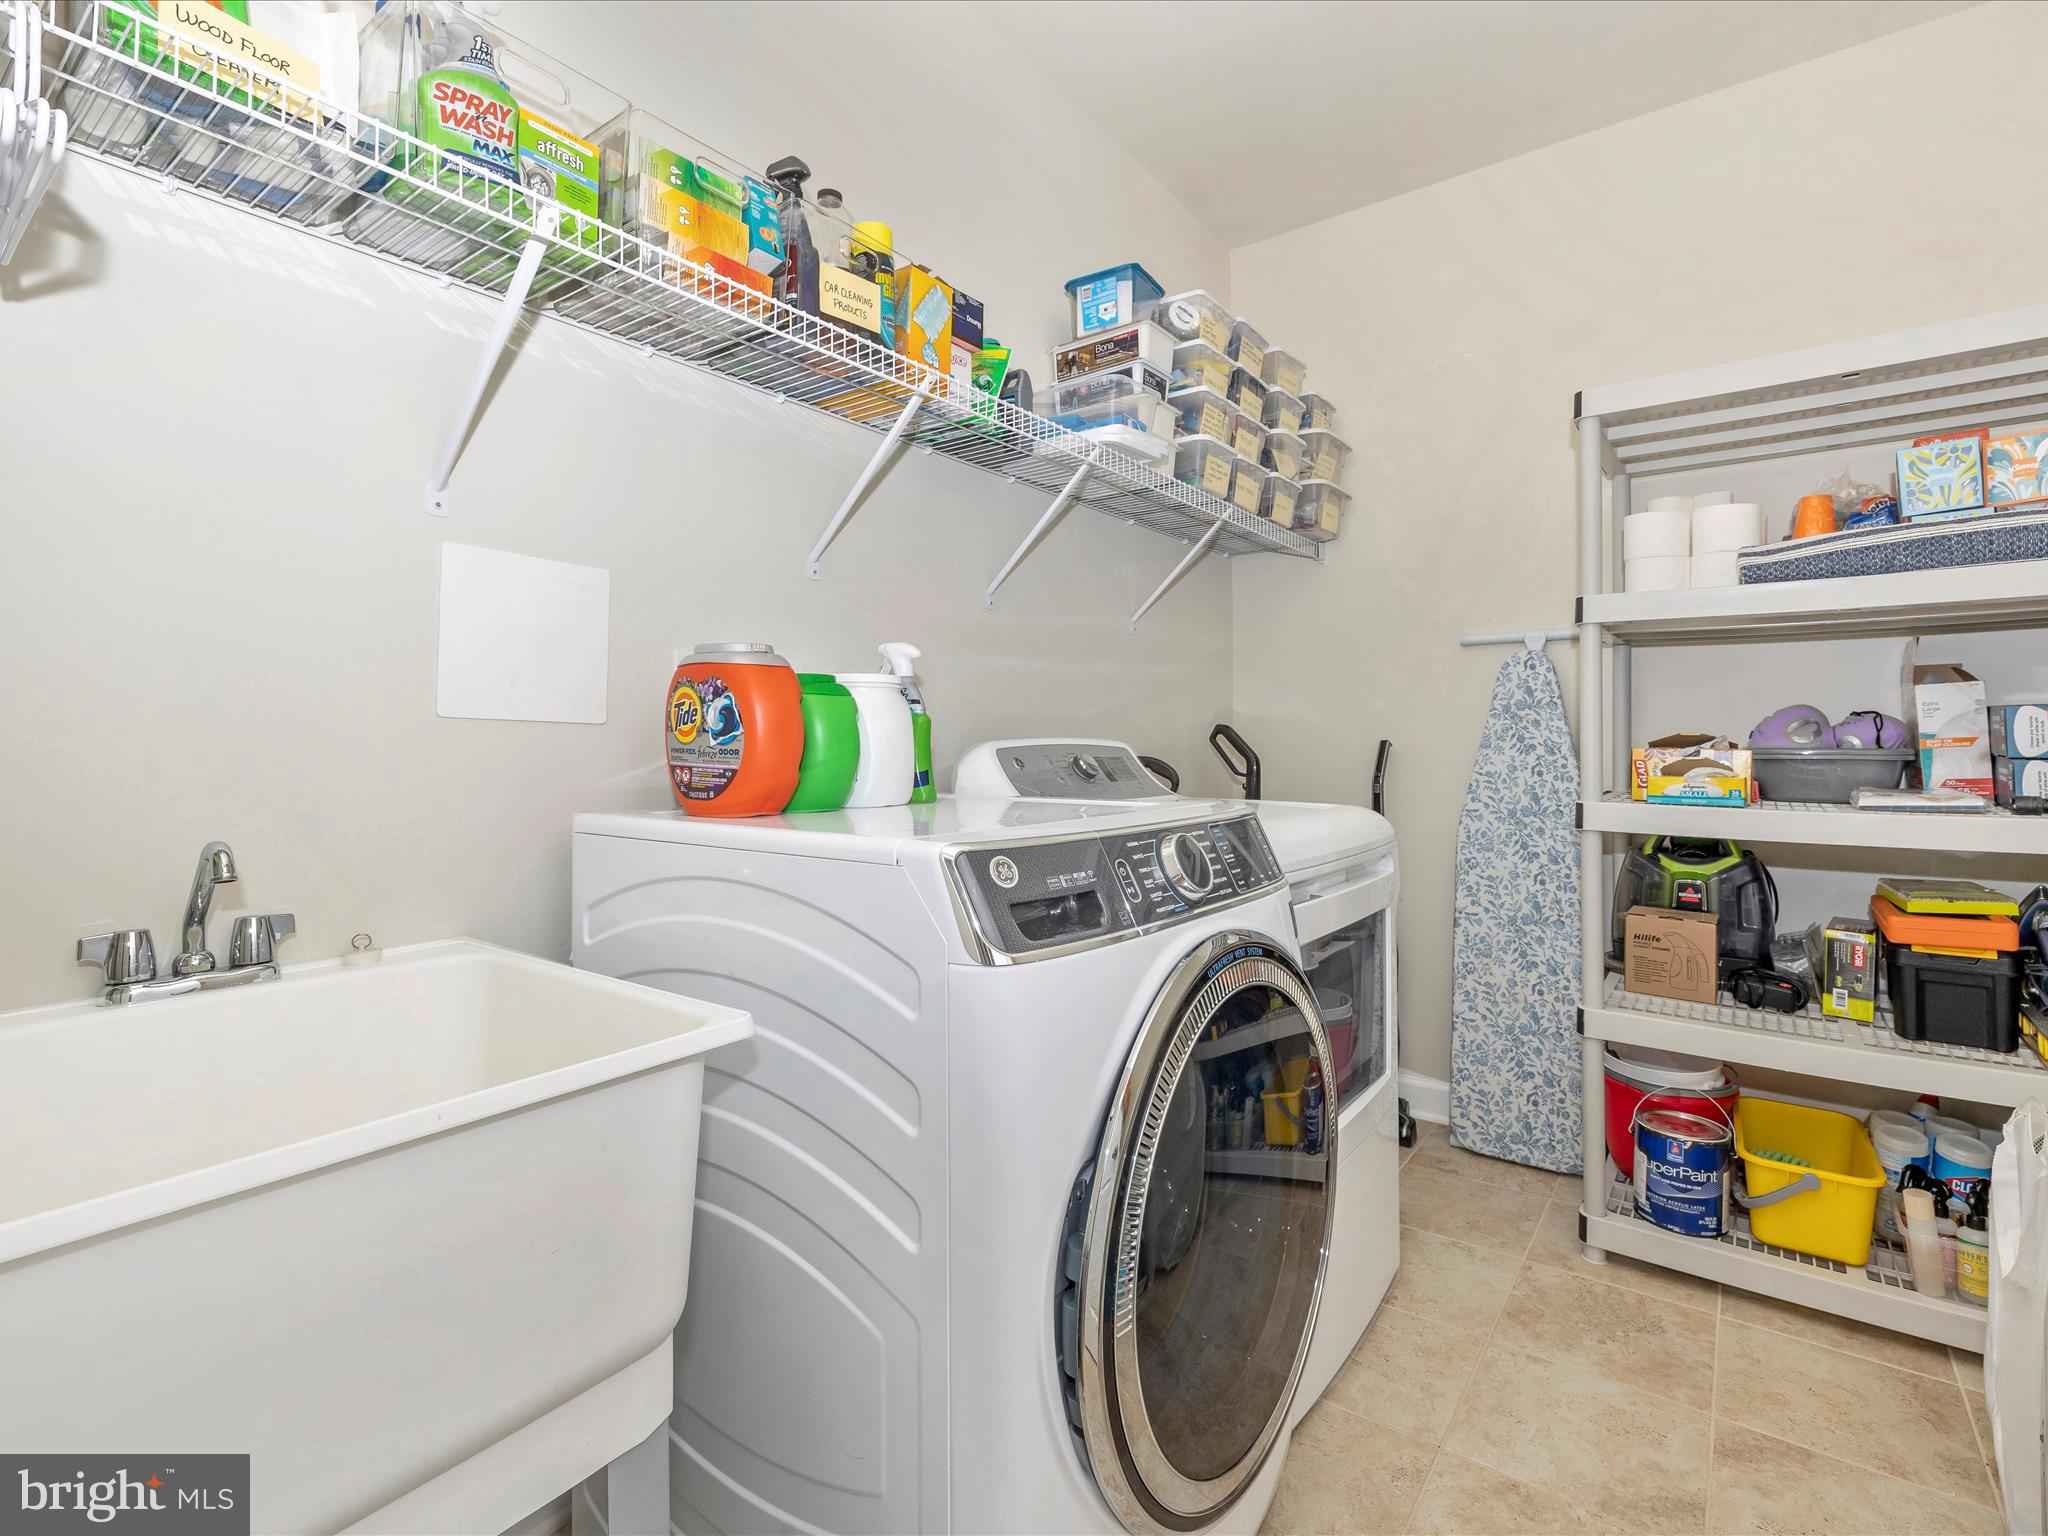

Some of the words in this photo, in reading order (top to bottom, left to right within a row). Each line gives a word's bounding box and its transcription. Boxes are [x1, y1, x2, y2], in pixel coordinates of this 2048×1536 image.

[176, 4, 233, 45] WOOD
[240, 37, 290, 76] FLOOR
[471, 49, 493, 62] TIM
[432, 81, 513, 125] SPRAY
[440, 105, 514, 147] WASH
[472, 139, 516, 163] MAX
[537, 140, 584, 172] affresh
[824, 281, 839, 295] CAR
[841, 288, 874, 309] CLEANING
[833, 298, 868, 319] PRODUCTS
[966, 315, 982, 330] Downy
[1095, 342, 1115, 354] Bona
[1145, 372, 1157, 386] Bona
[674, 700, 698, 732] Tide
[718, 748, 740, 756] ODOR
[1636, 760, 1648, 787] GLAD
[1633, 933, 1662, 943] Hilife
[1235, 948, 1246, 958] VENT
[1246, 947, 1263, 956] SYSTEM
[1854, 945, 1864, 967] RYOBI
[1647, 1160, 1718, 1183] uperPaint
[1668, 1199, 1690, 1209] ACRYLIC
